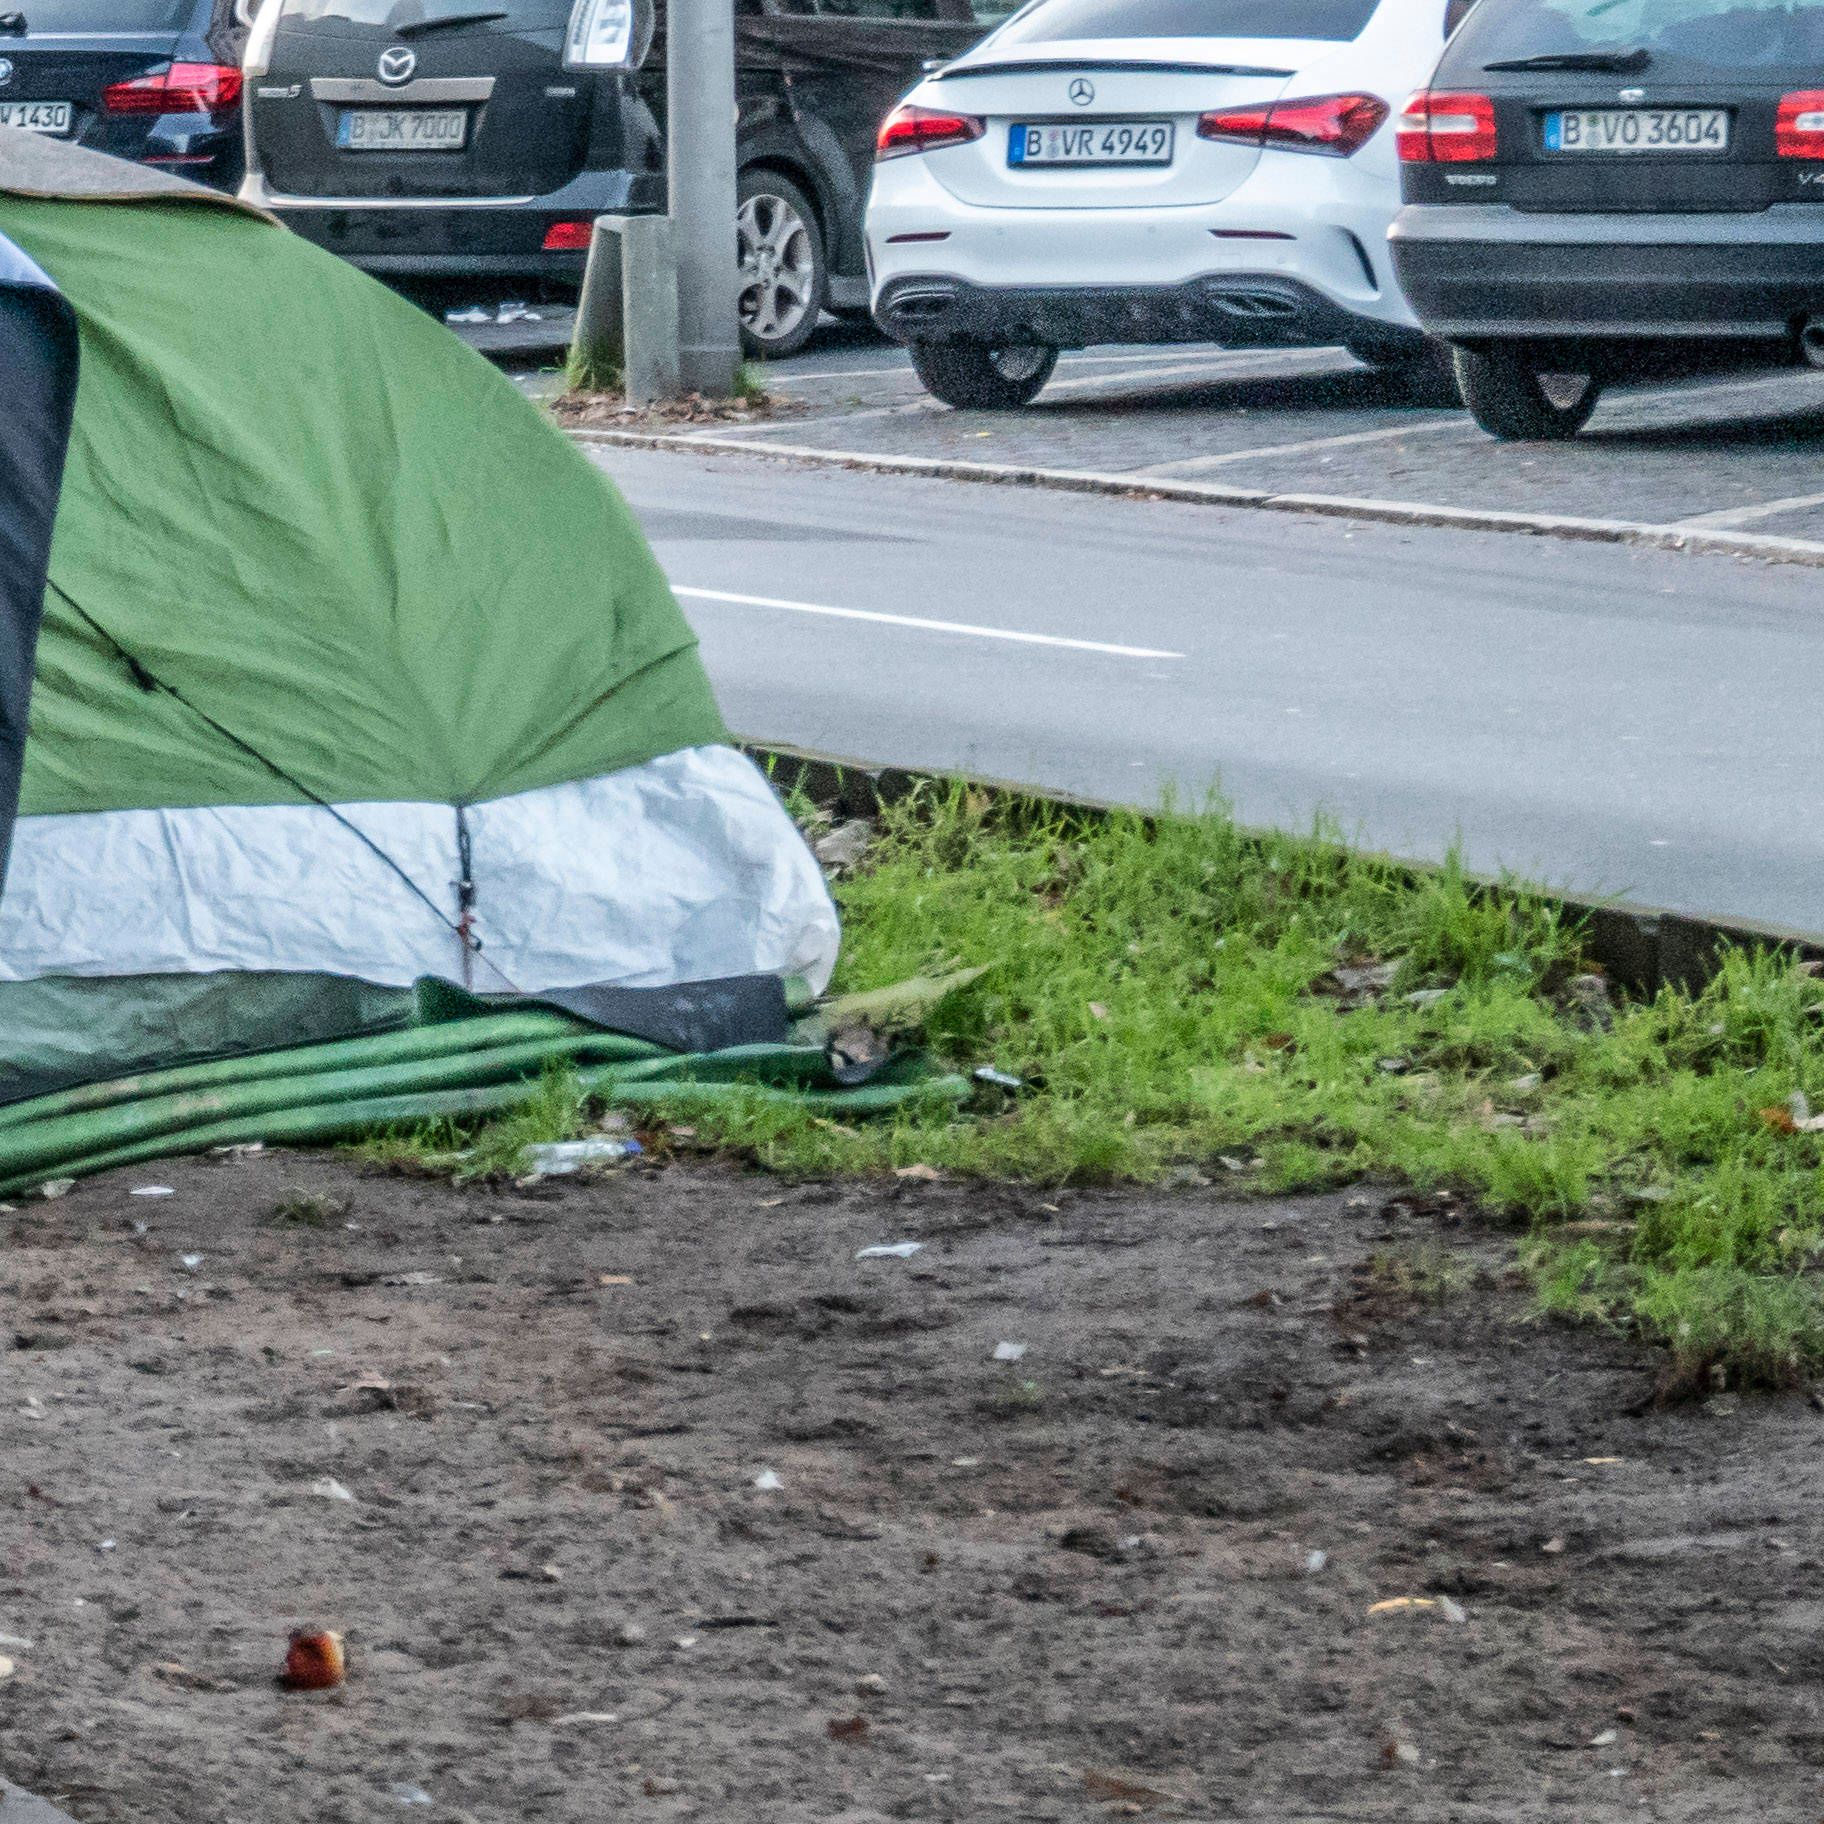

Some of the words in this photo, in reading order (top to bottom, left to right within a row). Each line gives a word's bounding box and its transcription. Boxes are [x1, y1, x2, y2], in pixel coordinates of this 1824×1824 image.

[16, 105, 68, 127] 1430
[353, 115, 365, 139] B
[410, 115, 462, 139] 7000
[1563, 114, 1580, 144] B
[1650, 113, 1721, 144] 3604
[1027, 130, 1042, 156] B
[1062, 129, 1094, 156] VR
[1100, 128, 1166, 156] 4949
